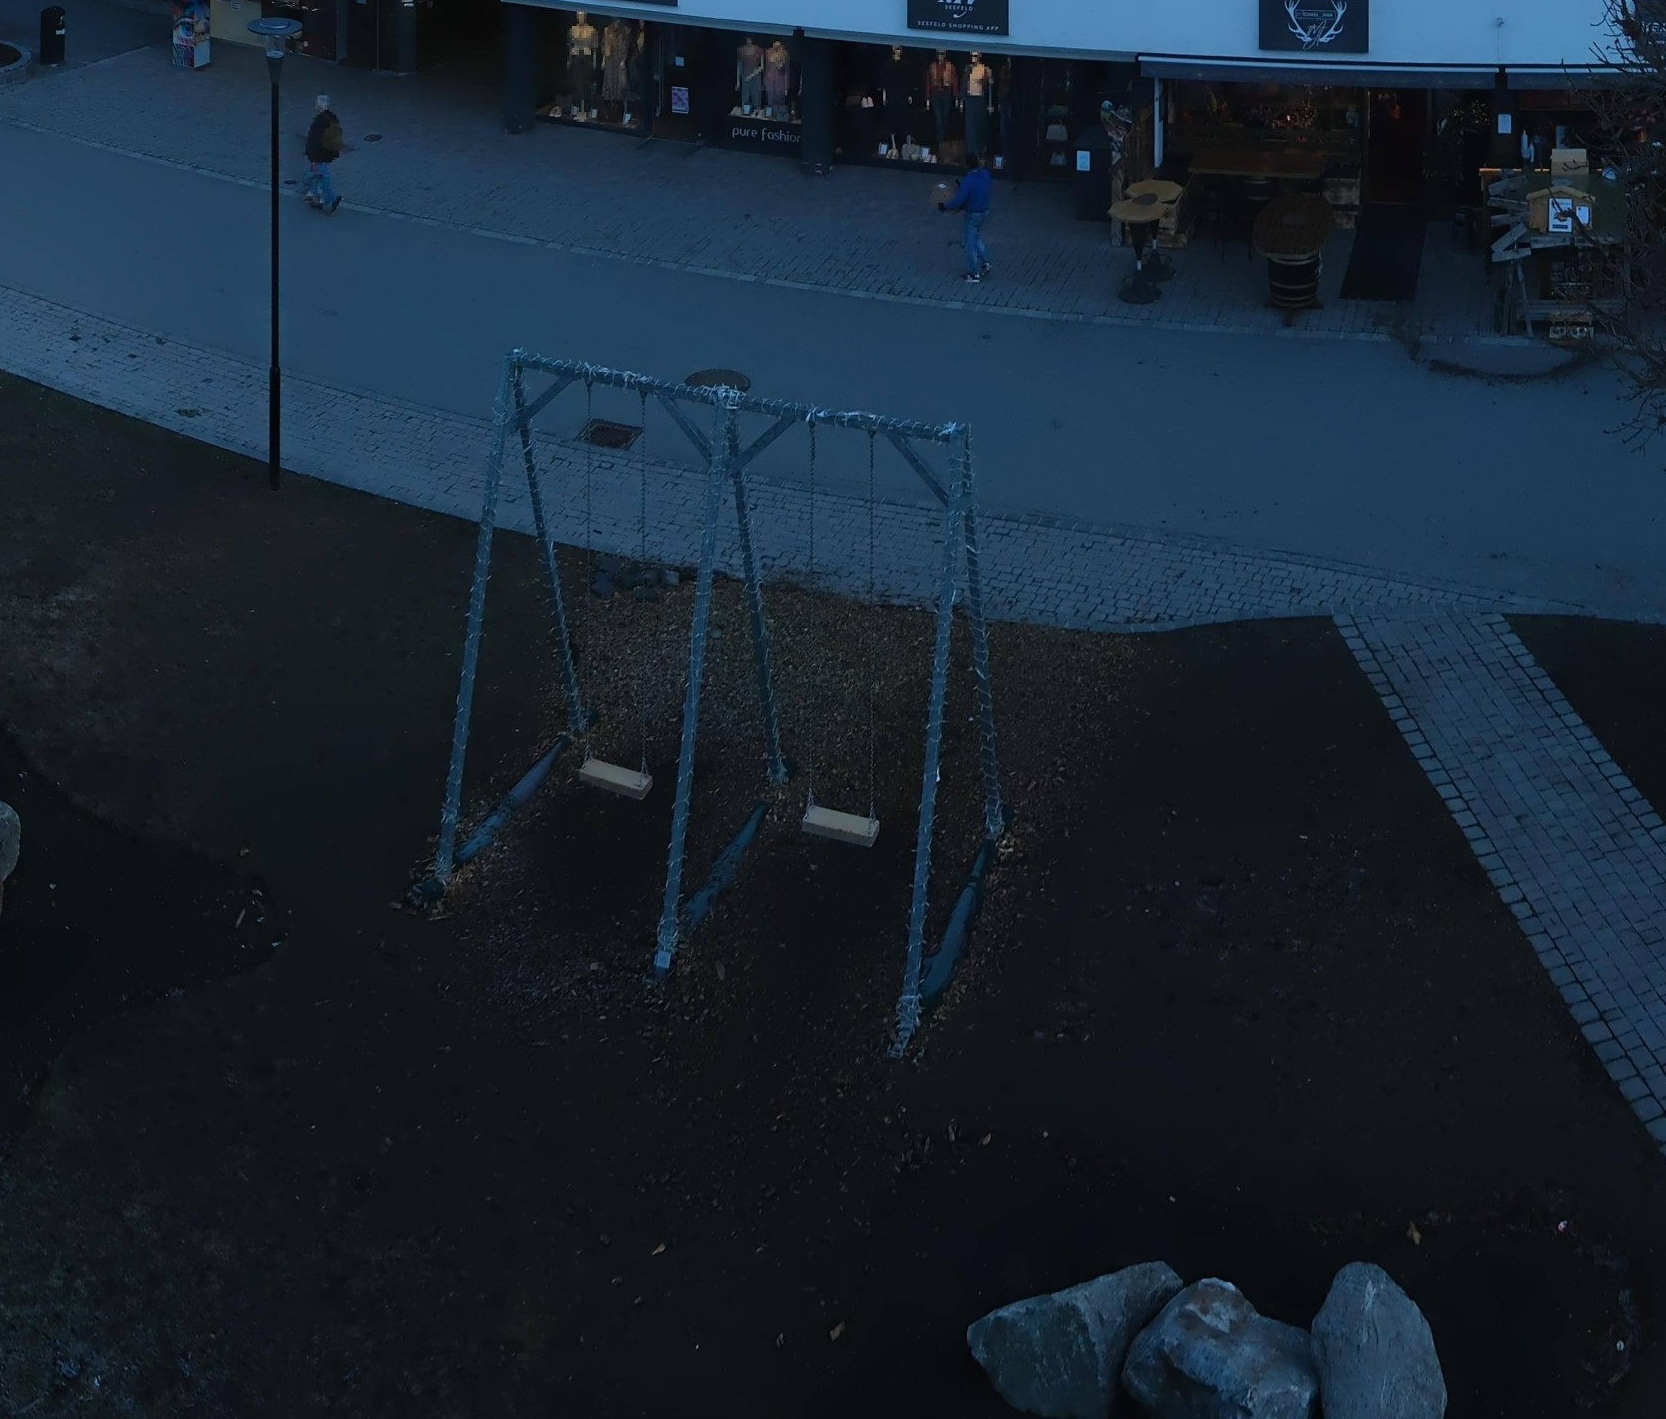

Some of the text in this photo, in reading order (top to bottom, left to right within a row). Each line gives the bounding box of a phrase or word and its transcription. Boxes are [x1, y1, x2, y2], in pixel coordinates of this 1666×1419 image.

[917, 20, 946, 28] SEEFELD
[948, 22, 984, 31] SHOPPING
[732, 127, 758, 138] pure
